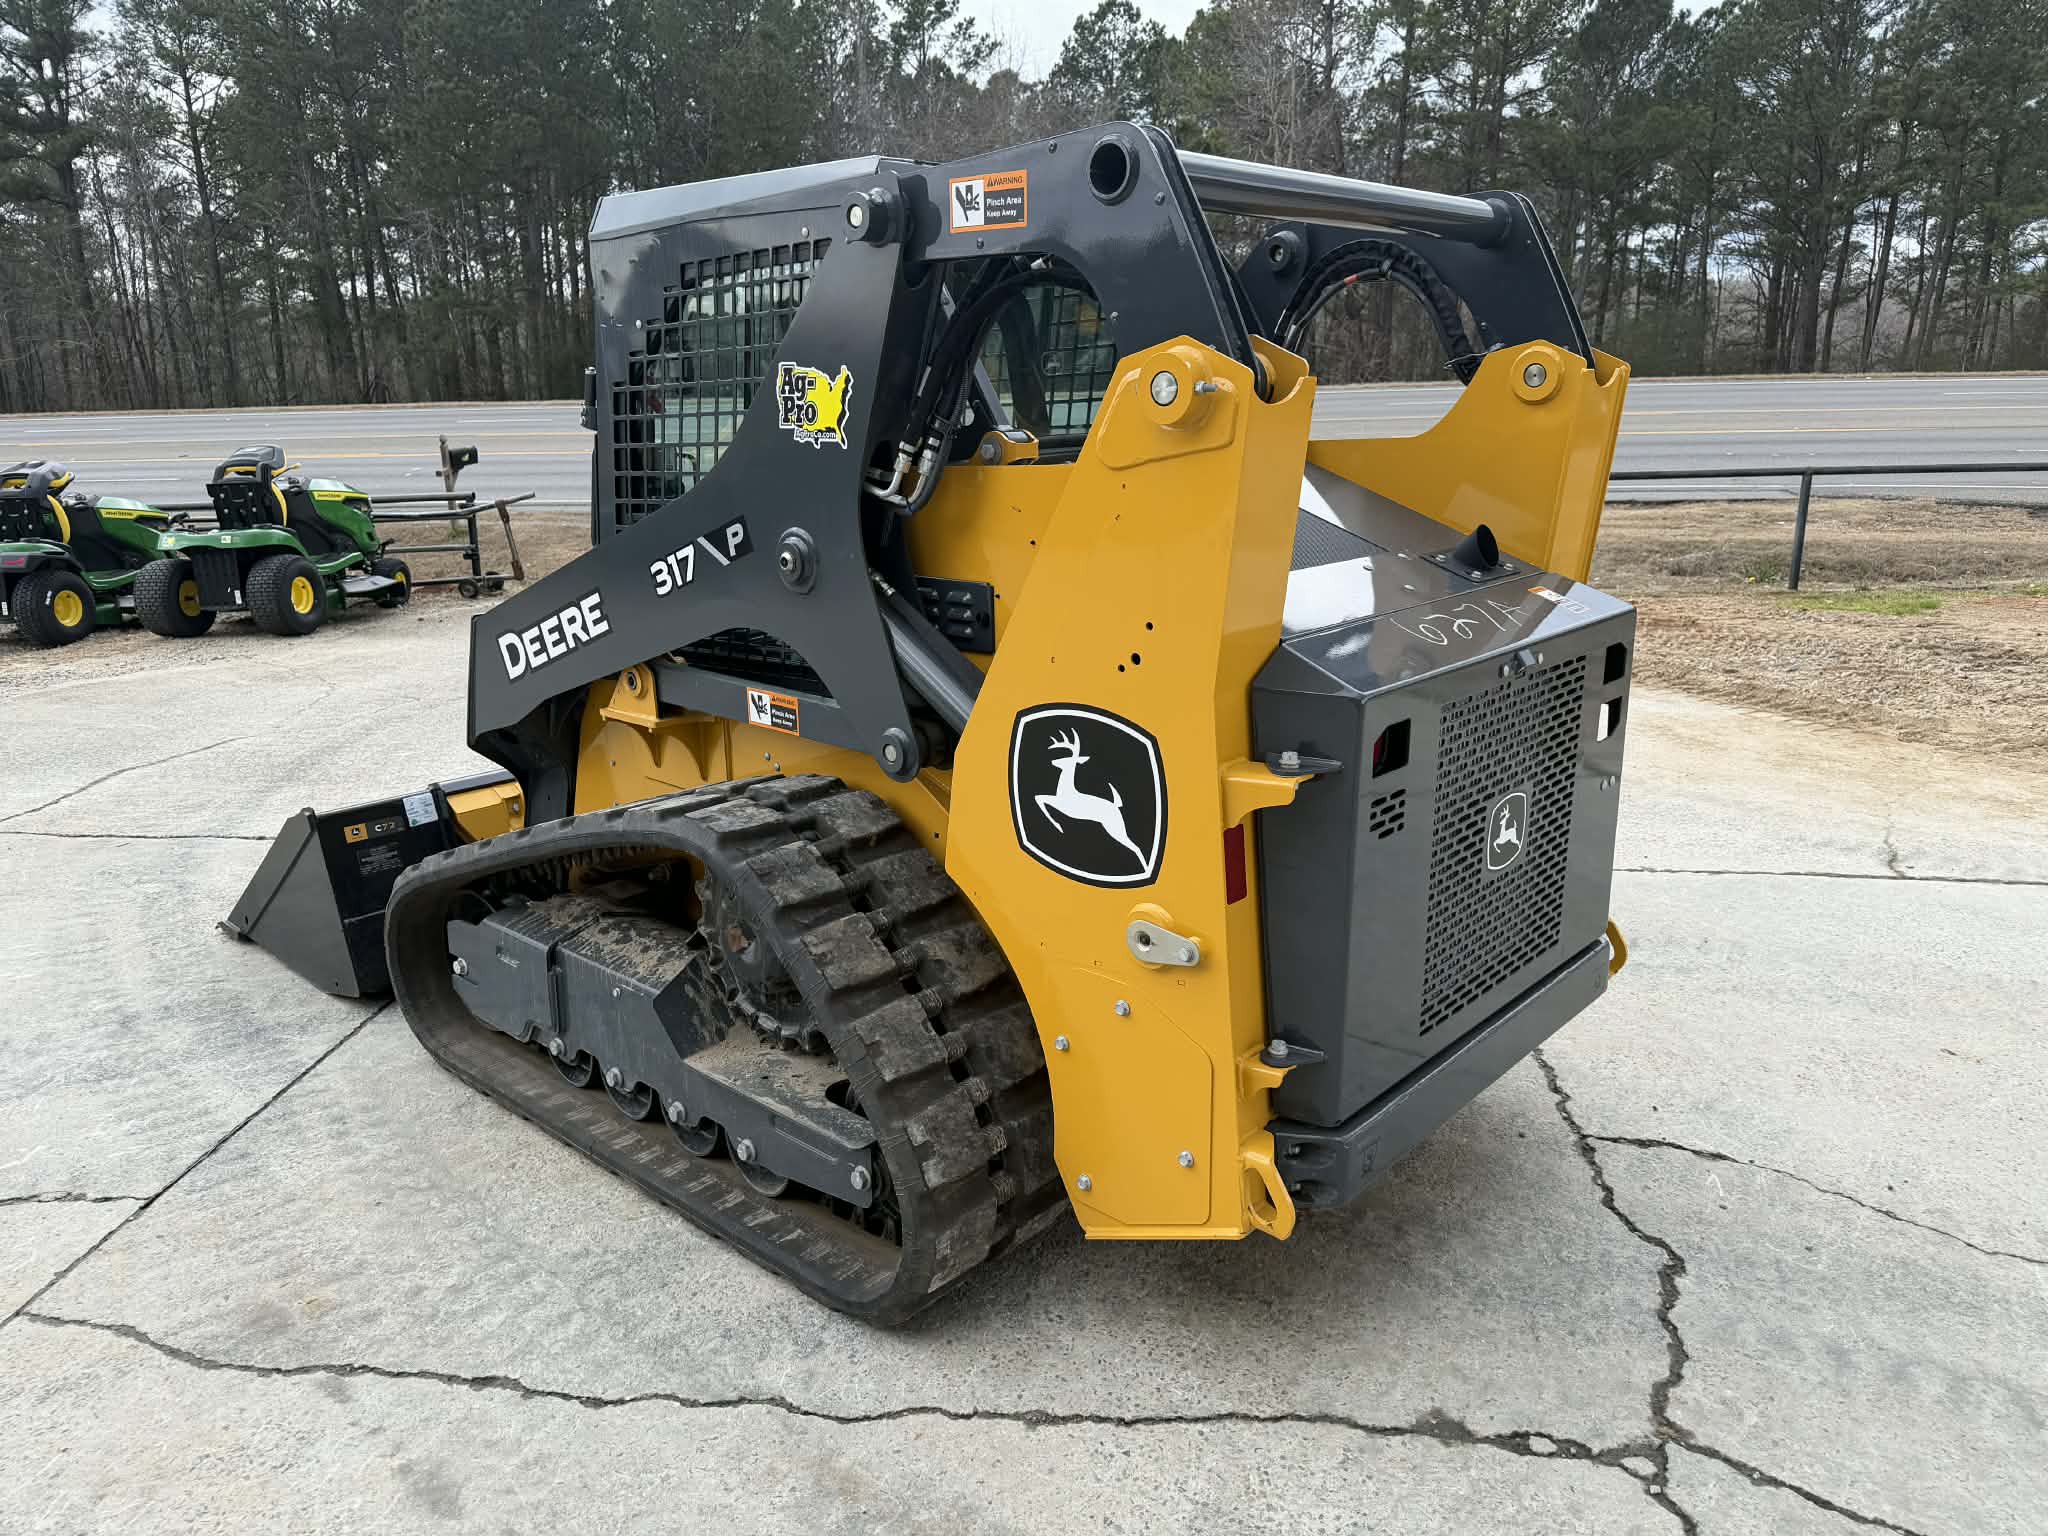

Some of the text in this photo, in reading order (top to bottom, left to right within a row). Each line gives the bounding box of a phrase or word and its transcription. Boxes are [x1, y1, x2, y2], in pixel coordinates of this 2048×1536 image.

[993, 175, 1023, 186] WARNING
[986, 196, 1022, 207] Pinch Area
[986, 209, 1017, 218] Keep Away
[779, 365, 816, 402] Ag-
[781, 395, 818, 426] Pro
[650, 543, 695, 596] 317
[497, 592, 609, 680] DEERE
